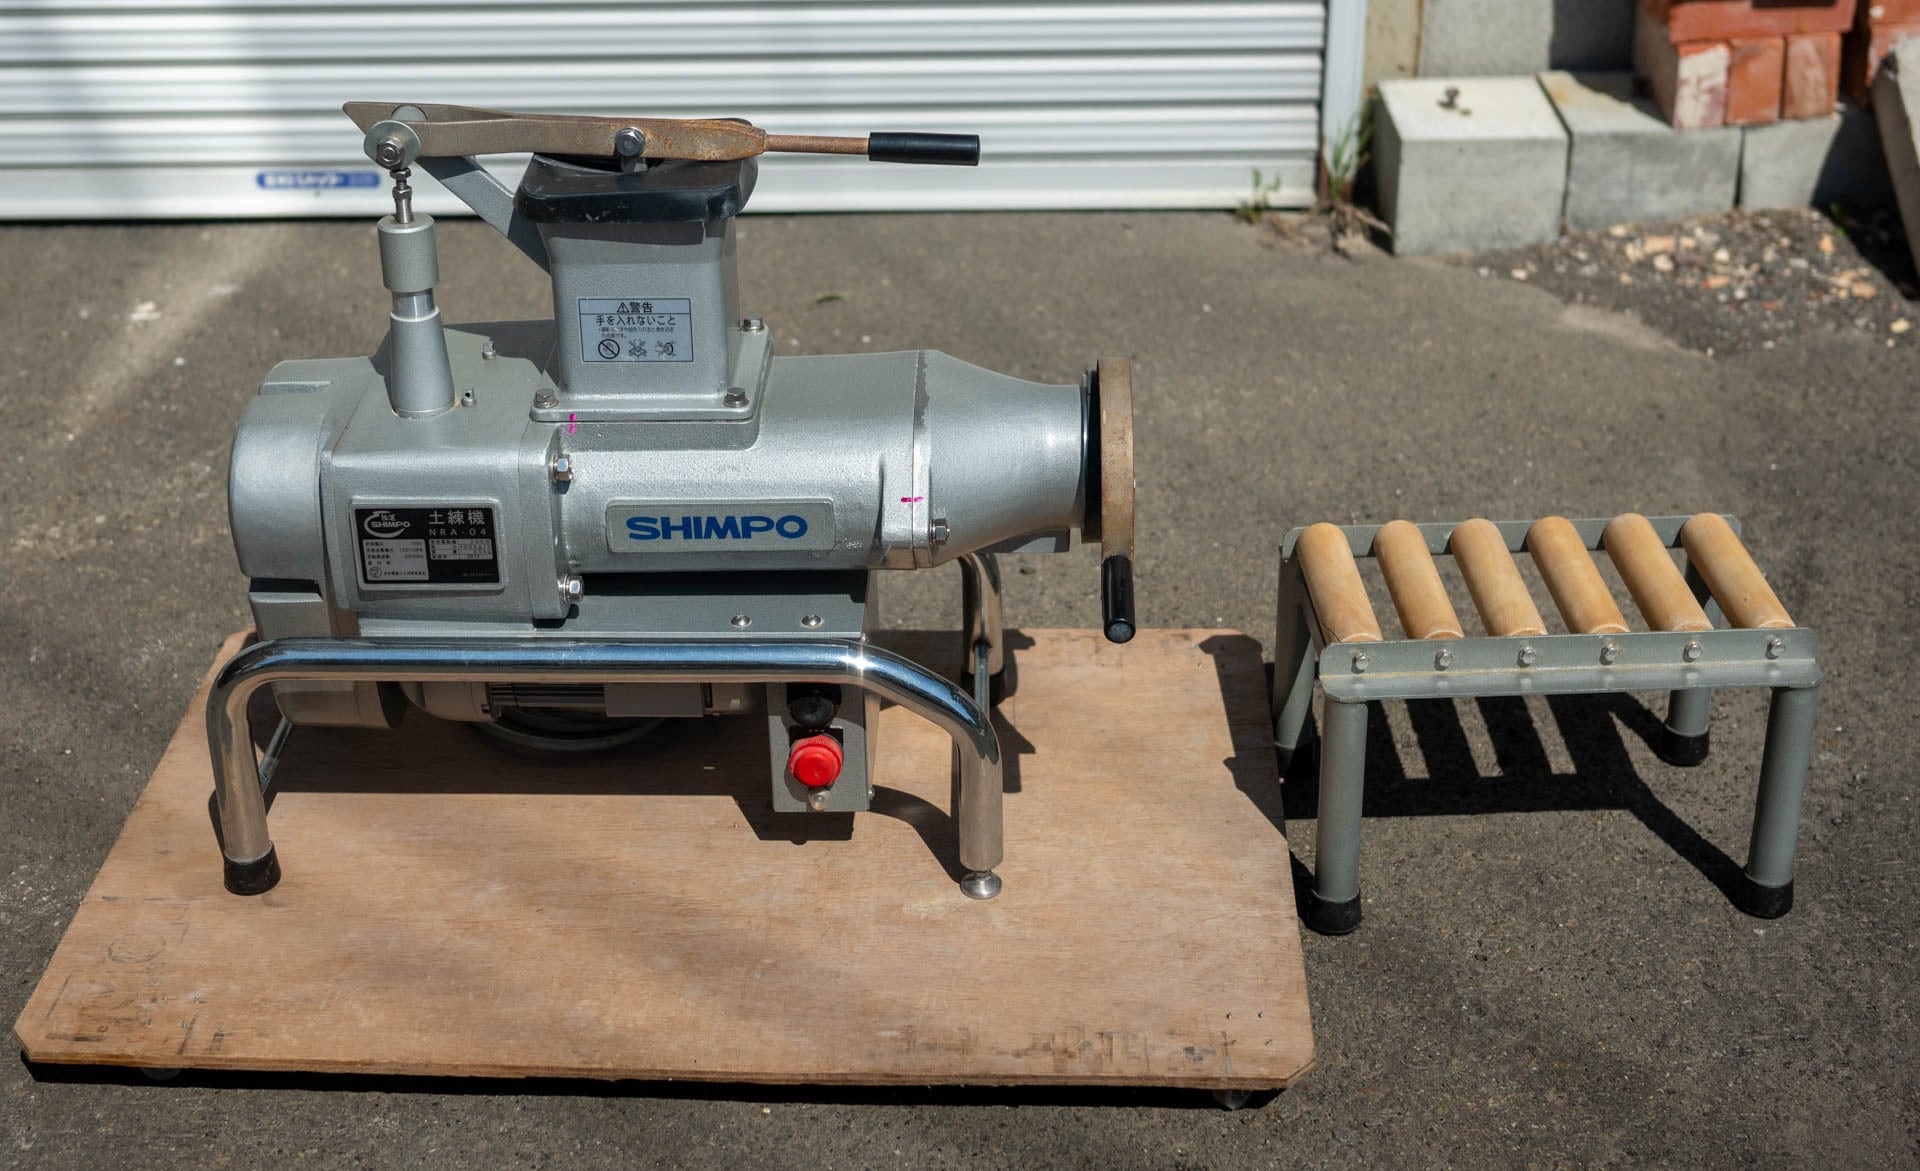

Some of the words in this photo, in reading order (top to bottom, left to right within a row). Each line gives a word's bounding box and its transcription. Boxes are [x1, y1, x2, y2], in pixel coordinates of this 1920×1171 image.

[629, 302, 654, 313] 警告
[595, 314, 676, 326] 手を入れないこと
[428, 509, 486, 525] 土練機
[626, 515, 808, 541] SHIMPO
